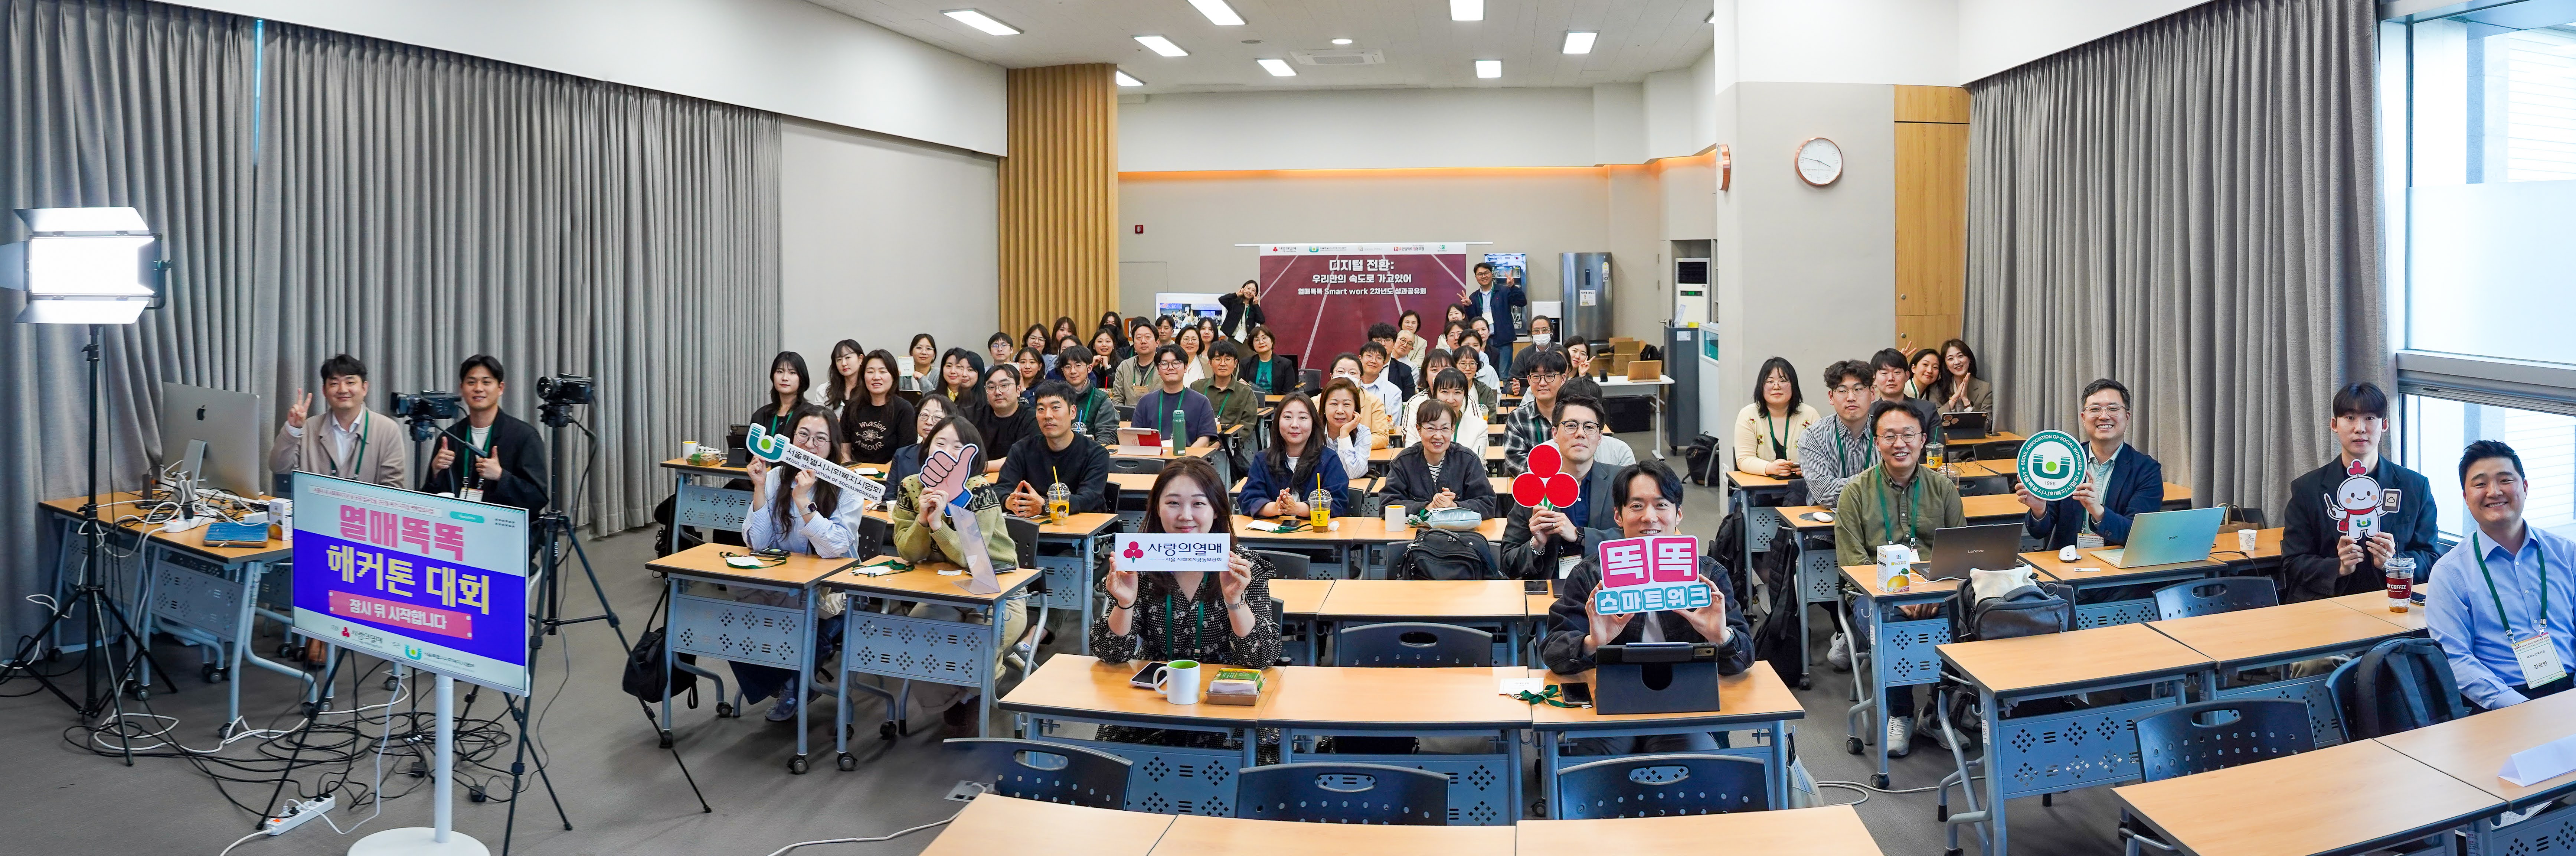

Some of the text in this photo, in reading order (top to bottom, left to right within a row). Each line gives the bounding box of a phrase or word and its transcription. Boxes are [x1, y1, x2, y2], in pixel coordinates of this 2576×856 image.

[1329, 259, 1394, 271] 디지털 전환:
[1312, 274, 1412, 283] 우리만의 속도로 가고있어
[2026, 434, 2052, 451] ASSOCIATION
[2059, 437, 2074, 449] SOCIAL
[2073, 448, 2082, 471] WORKERS
[786, 457, 800, 466] SEOUL
[801, 464, 831, 479] ASSIATION
[340, 504, 464, 562] 열매똑똑
[1148, 543, 1222, 556] 사랑의열매
[1606, 543, 1692, 579] 똑똑
[326, 545, 489, 615] 해커톤 대회
[1600, 587, 1708, 611] 스마트워크
[349, 599, 447, 629] 잠시 뒤 시작합니다
[2534, 661, 2548, 669] 김관영
